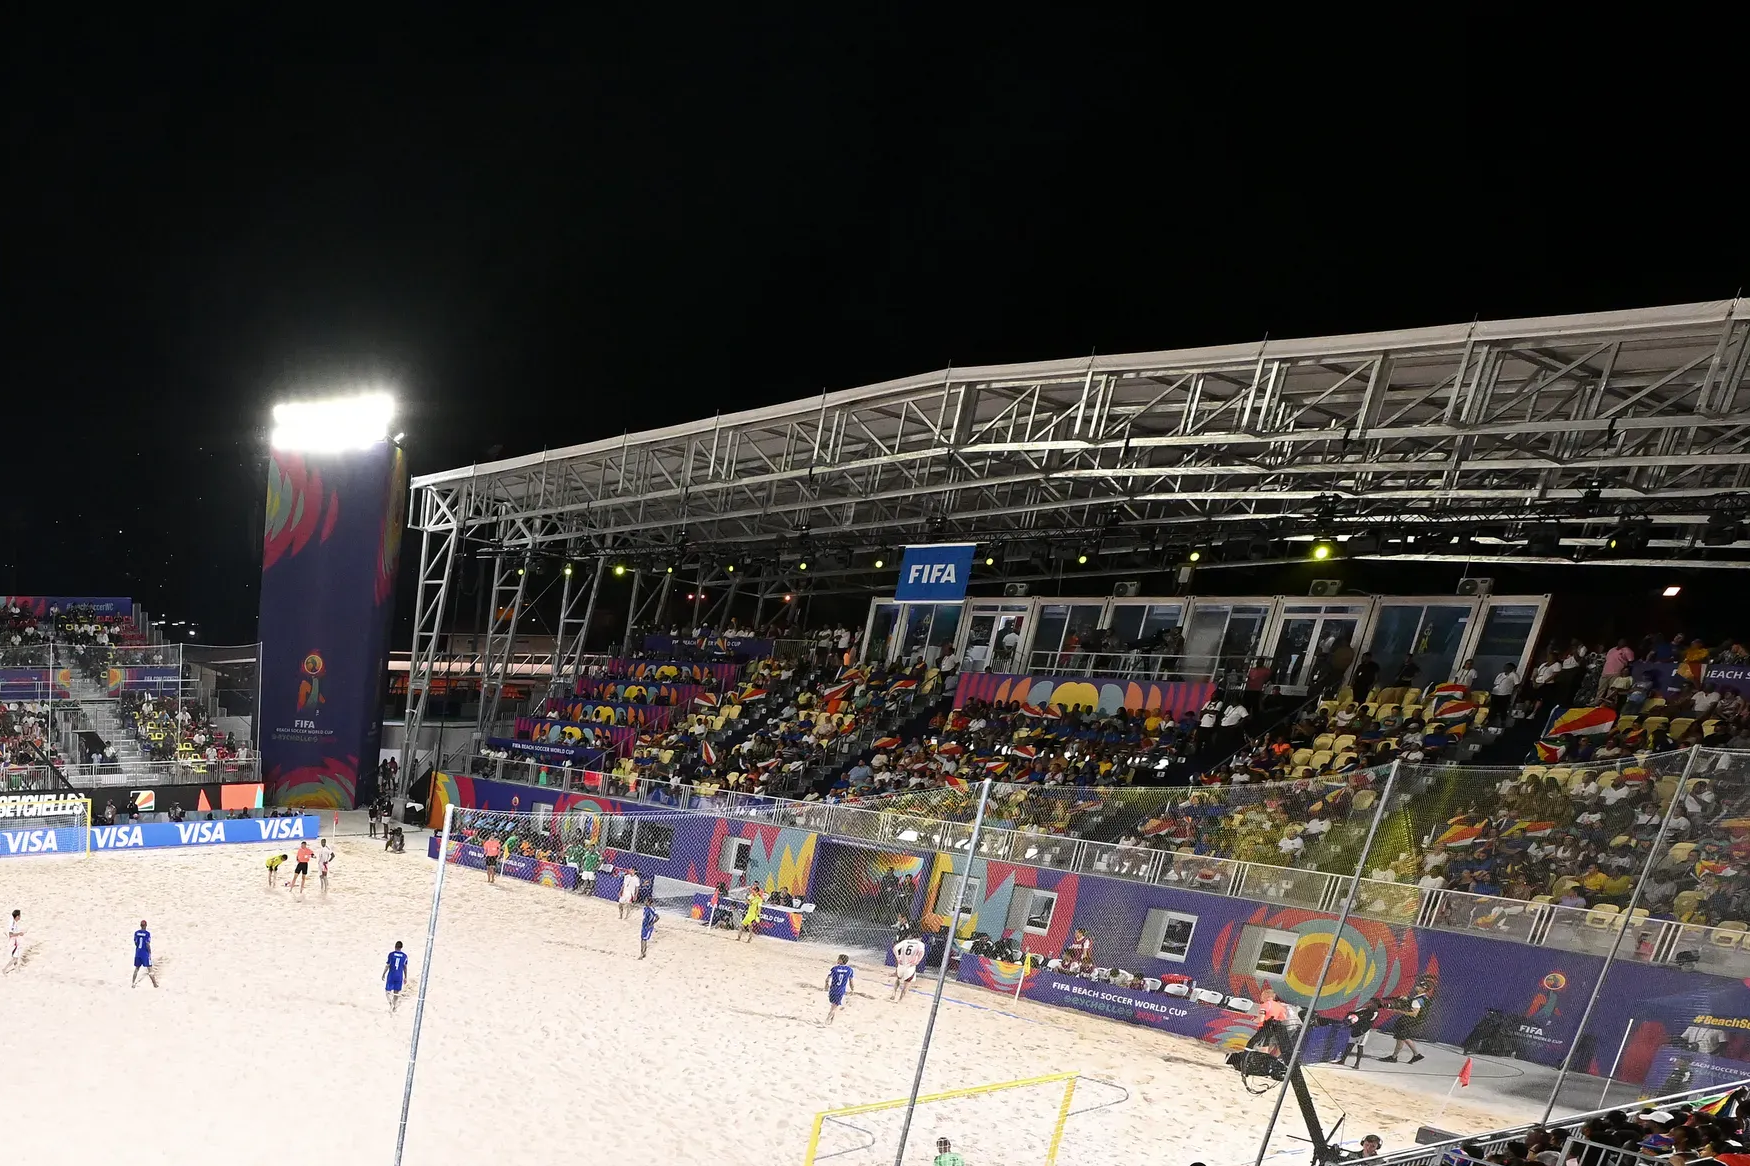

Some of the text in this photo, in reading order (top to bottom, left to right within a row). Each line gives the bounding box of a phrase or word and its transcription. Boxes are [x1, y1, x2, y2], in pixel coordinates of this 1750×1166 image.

[908, 564, 956, 584] FIFA
[294, 720, 315, 729] FIFA
[91, 825, 144, 849] VISA
[174, 821, 226, 844] VISA
[254, 817, 304, 840] VISA
[2, 830, 57, 853] VISA
[1053, 981, 1188, 1017] FIFA BEACH SOCCER WORLD CUP
[1519, 1024, 1543, 1036] FIFA
[1711, 1063, 1739, 1075] SOCCER
